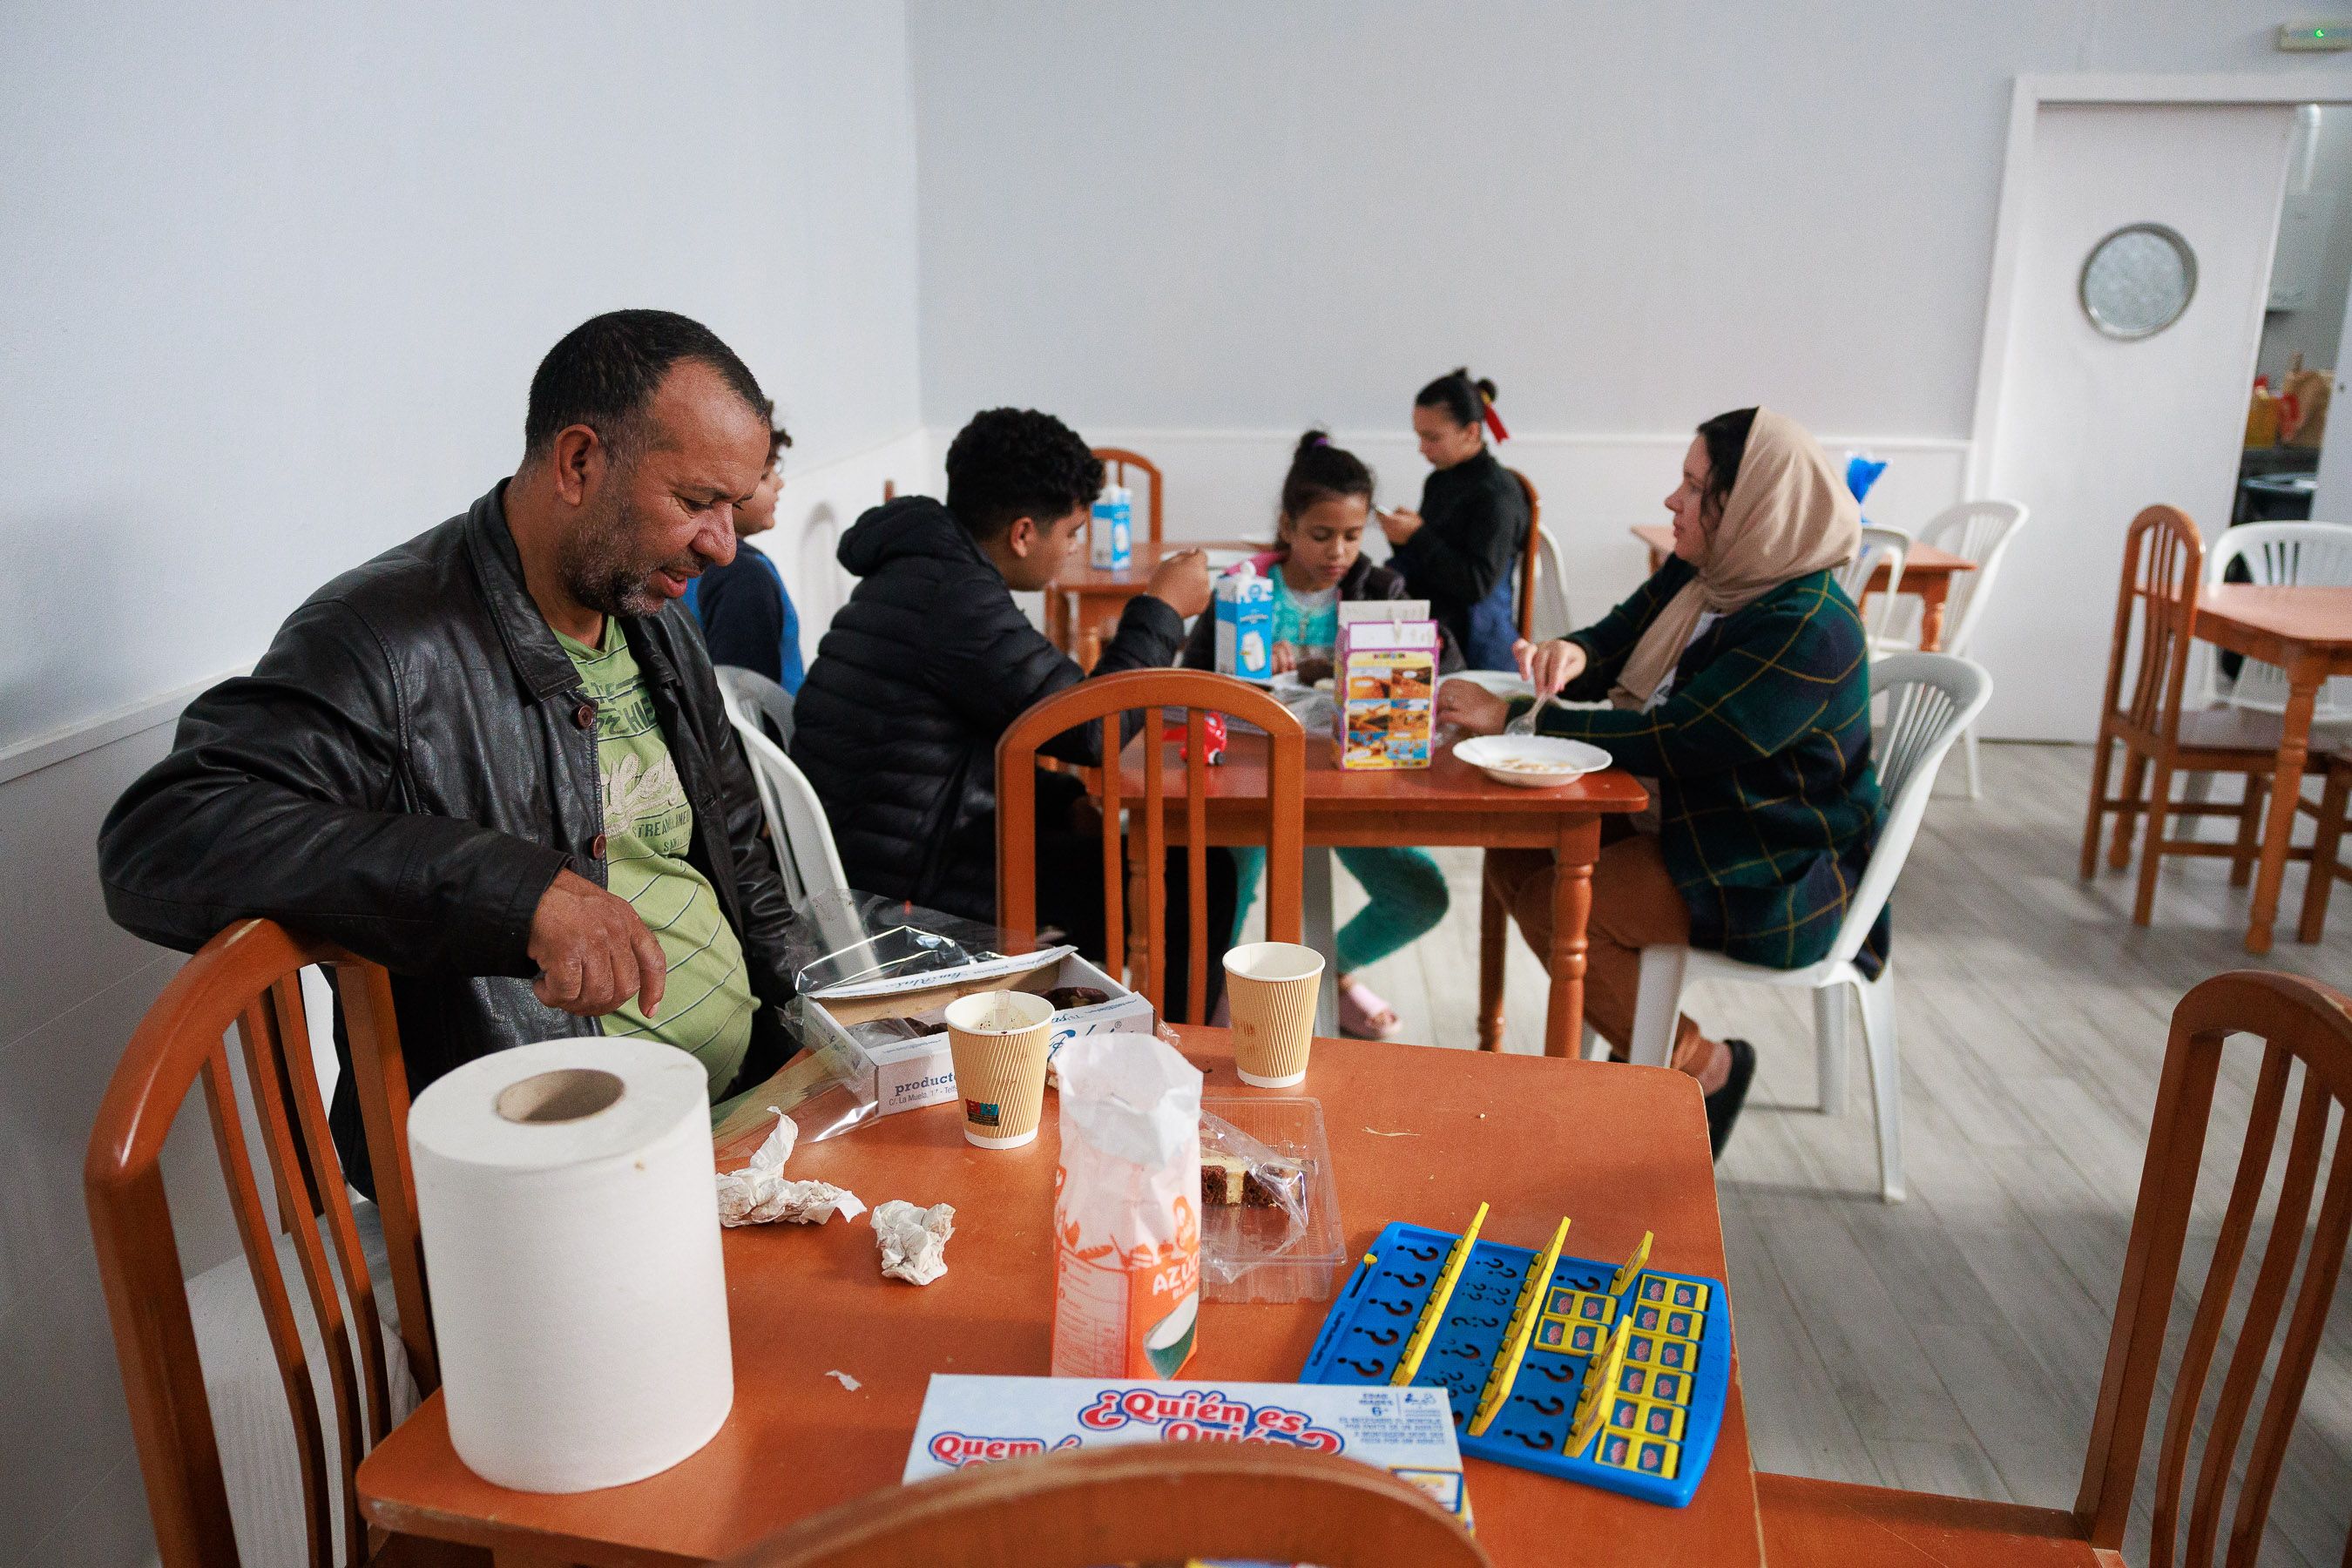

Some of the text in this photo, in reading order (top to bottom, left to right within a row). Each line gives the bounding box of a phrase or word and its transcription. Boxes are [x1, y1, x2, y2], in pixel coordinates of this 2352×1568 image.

[895, 1072, 956, 1097] product
[1083, 1392, 1305, 1433] ¿Quién es
[934, 1436, 1040, 1463] Quem
